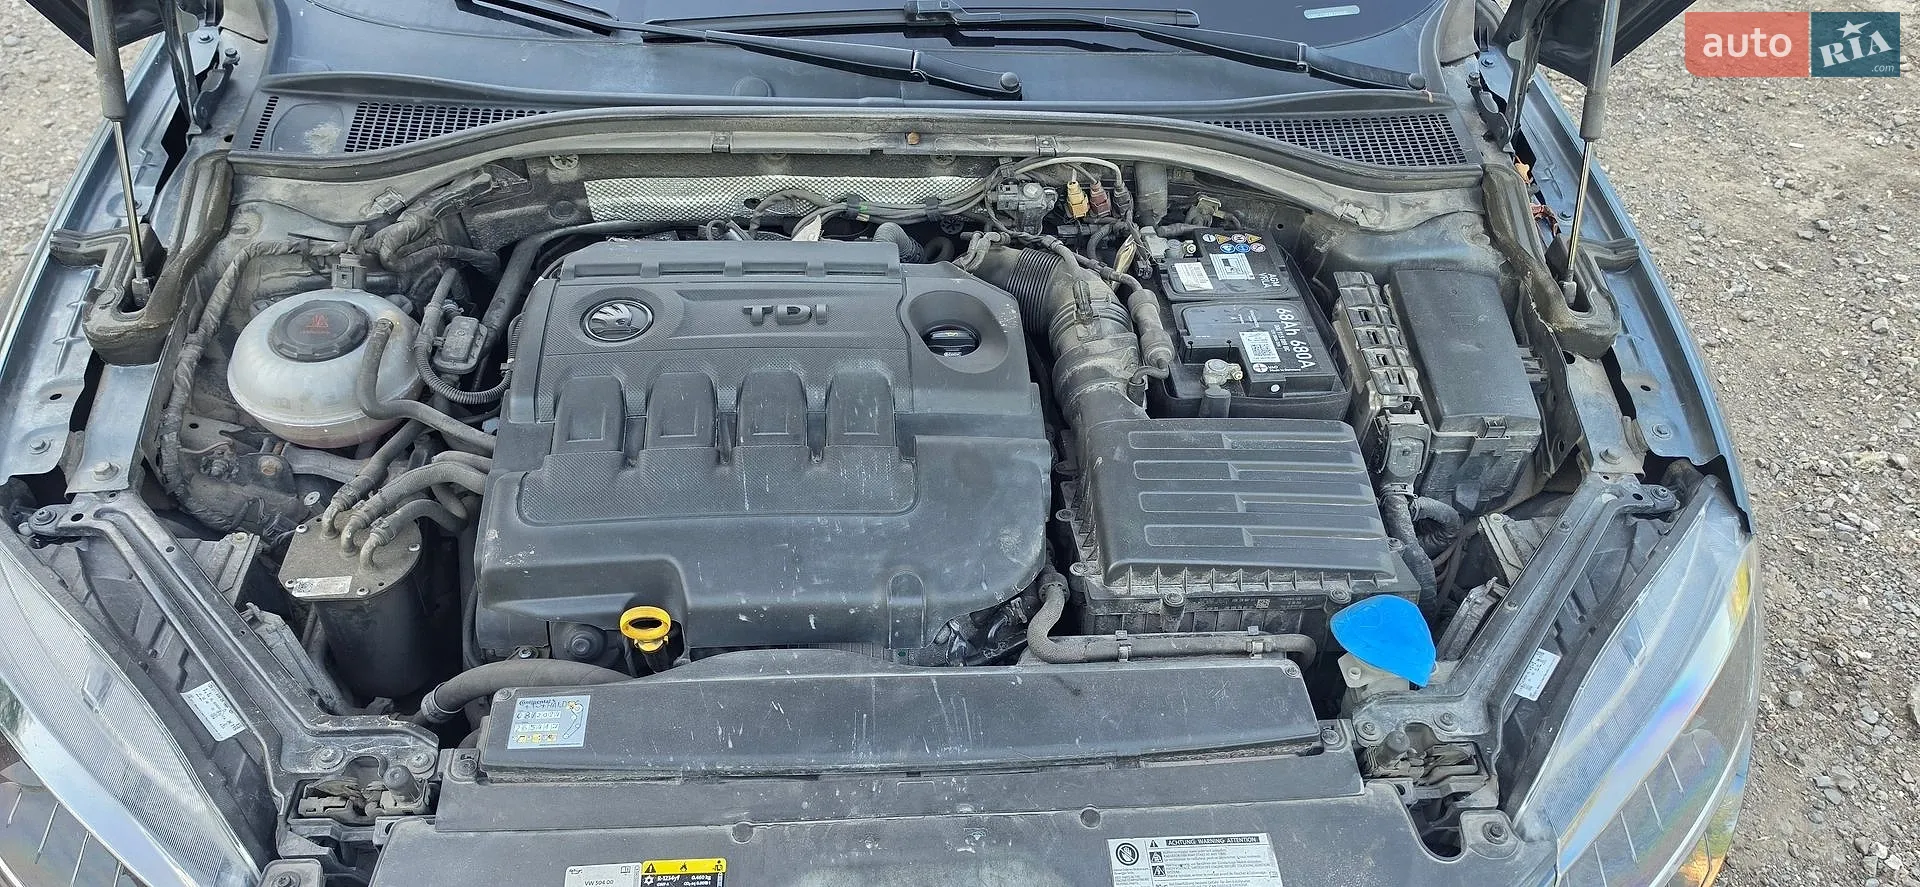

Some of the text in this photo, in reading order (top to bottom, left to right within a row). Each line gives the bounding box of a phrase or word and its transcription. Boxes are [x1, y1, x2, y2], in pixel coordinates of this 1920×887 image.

[742, 304, 828, 326] TDI
[1276, 307, 1298, 336] 68Ah
[1290, 339, 1315, 369] 680A
